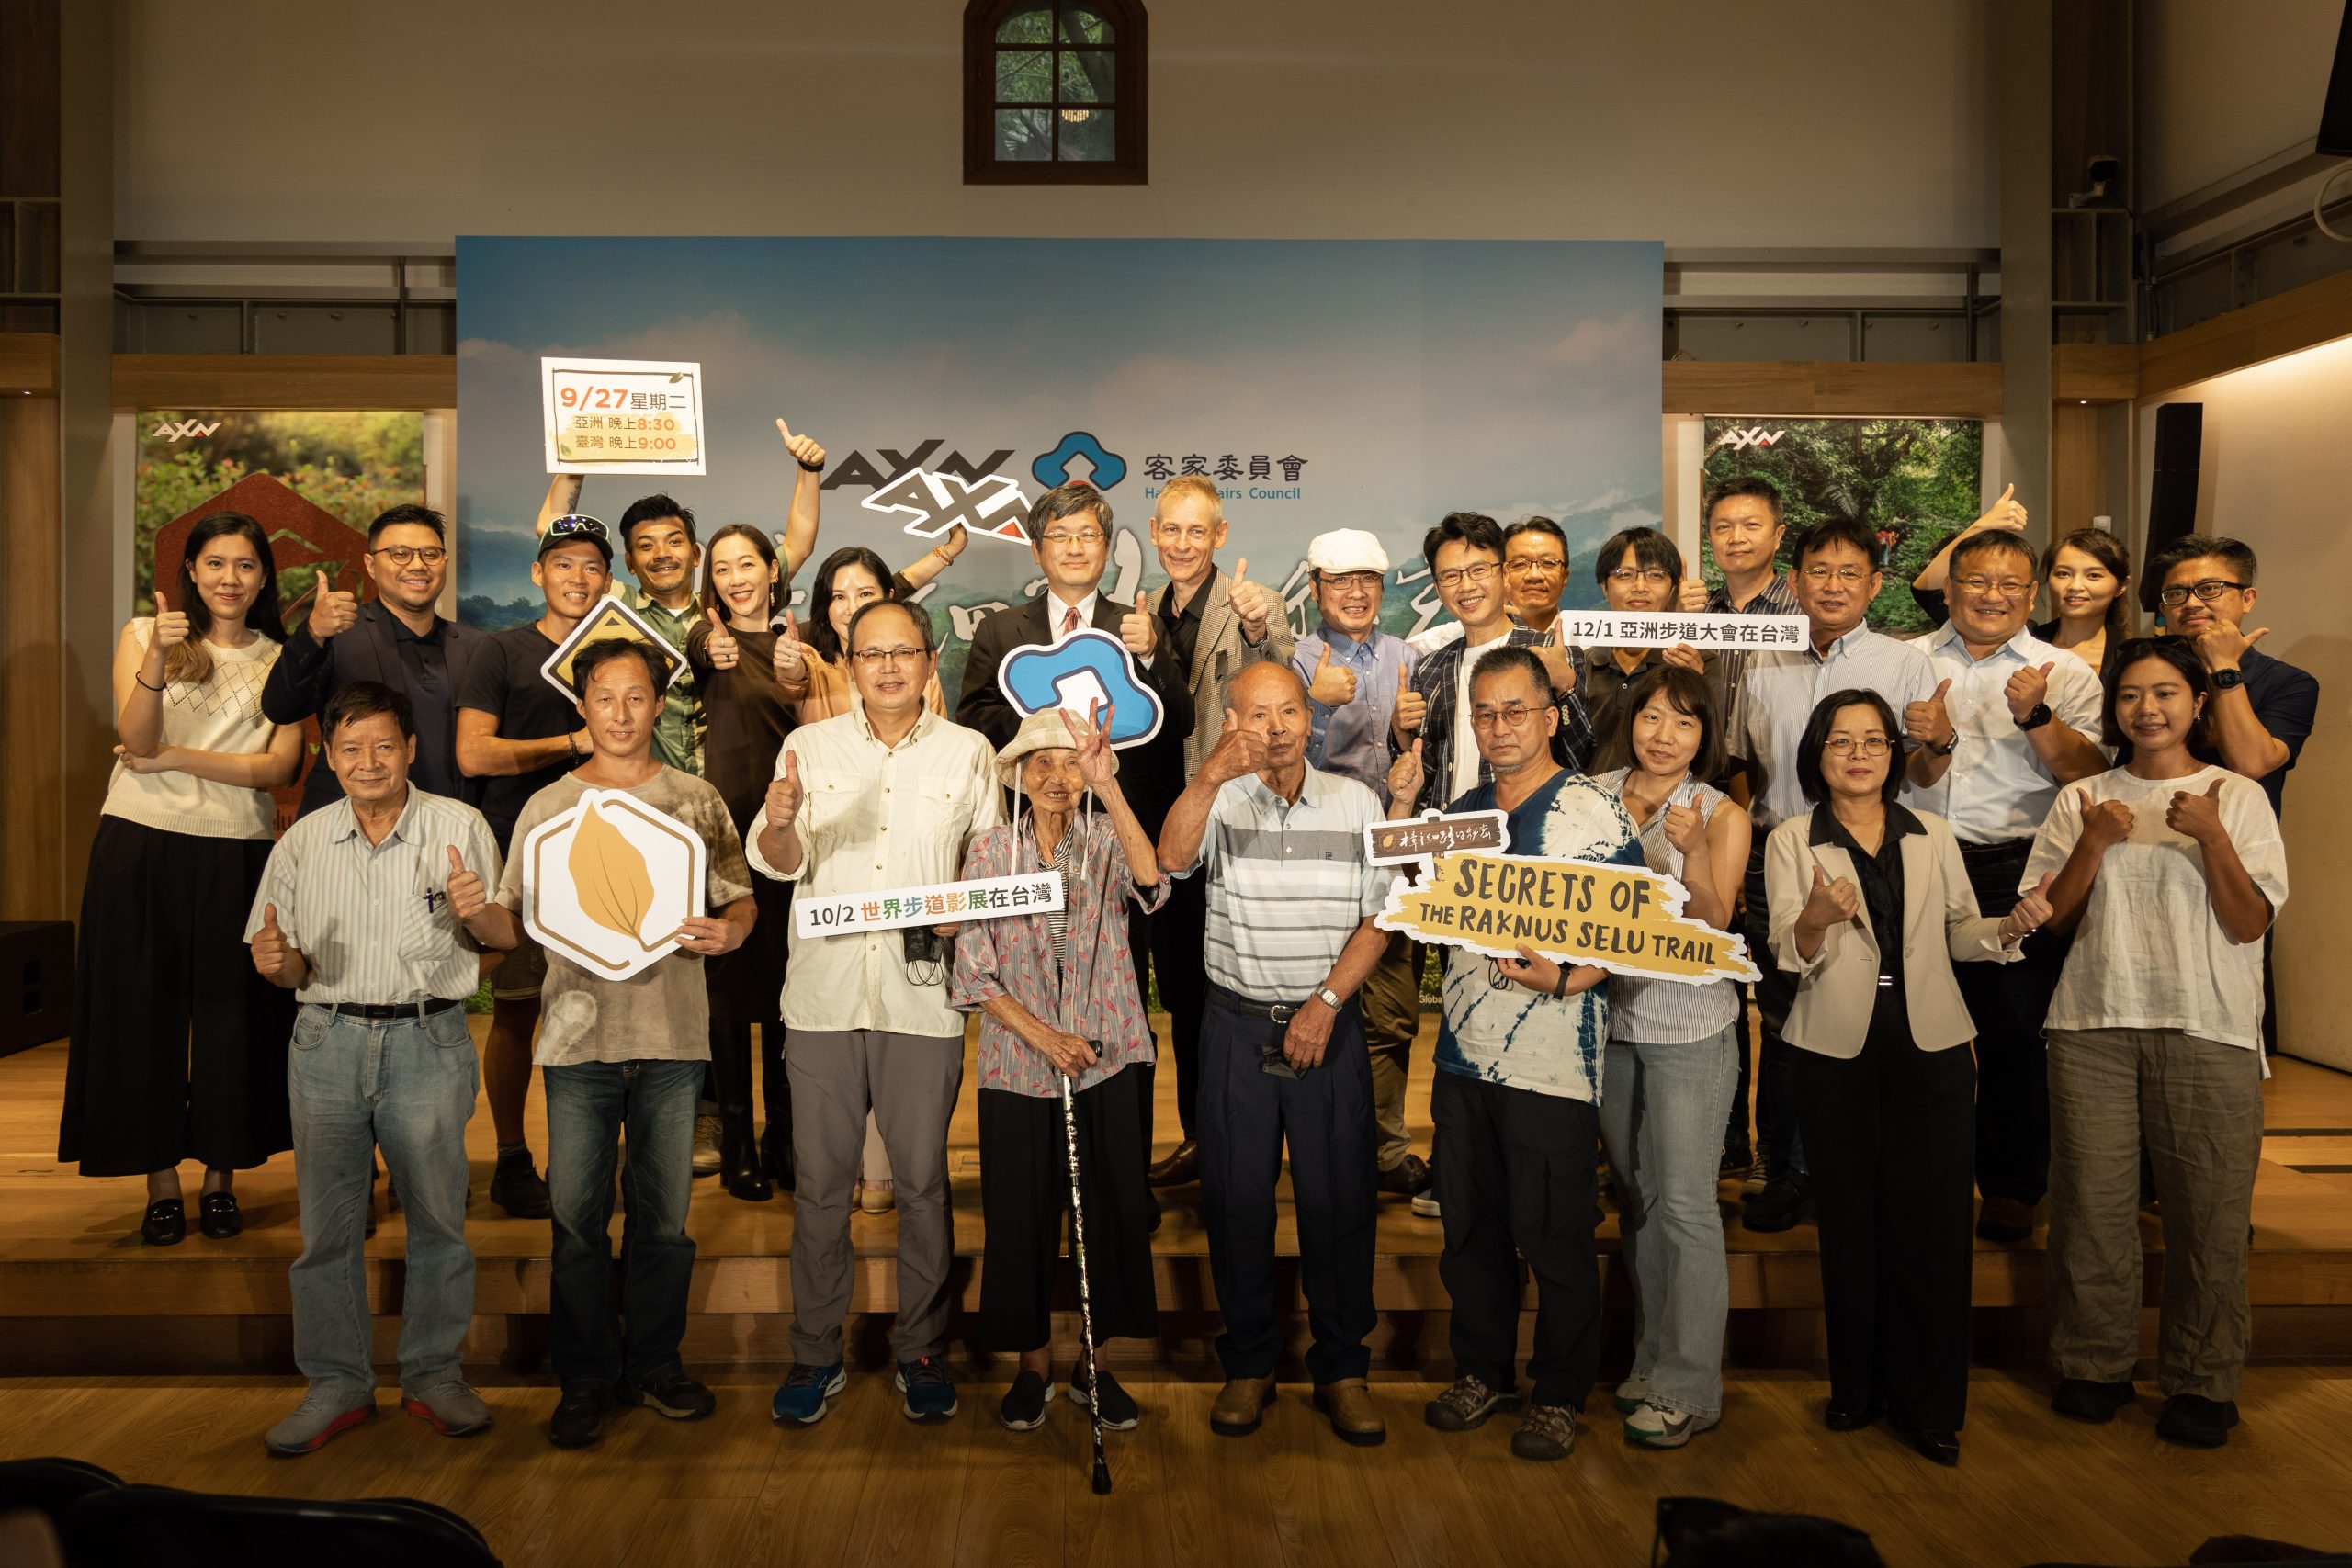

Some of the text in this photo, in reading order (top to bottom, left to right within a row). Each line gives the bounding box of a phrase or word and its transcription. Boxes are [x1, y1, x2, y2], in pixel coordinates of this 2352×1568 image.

[152, 419, 222, 443] AXN
[575, 416, 603, 430] 亞洲
[575, 435, 604, 449] 臺灣
[1718, 427, 1786, 450] AXN
[1144, 454, 1308, 481] 客家委員會
[1250, 487, 1301, 499] Council
[1573, 619, 1801, 644] 12/1 亞洲步道大會在台灣
[1454, 859, 1651, 919] SECRETS OF
[809, 882, 1053, 927] 10/2 世界步道影展在台灣
[1420, 902, 1716, 965] THE RAKNUS SELU TRAIL
[1419, 995, 1443, 1004] Globa
